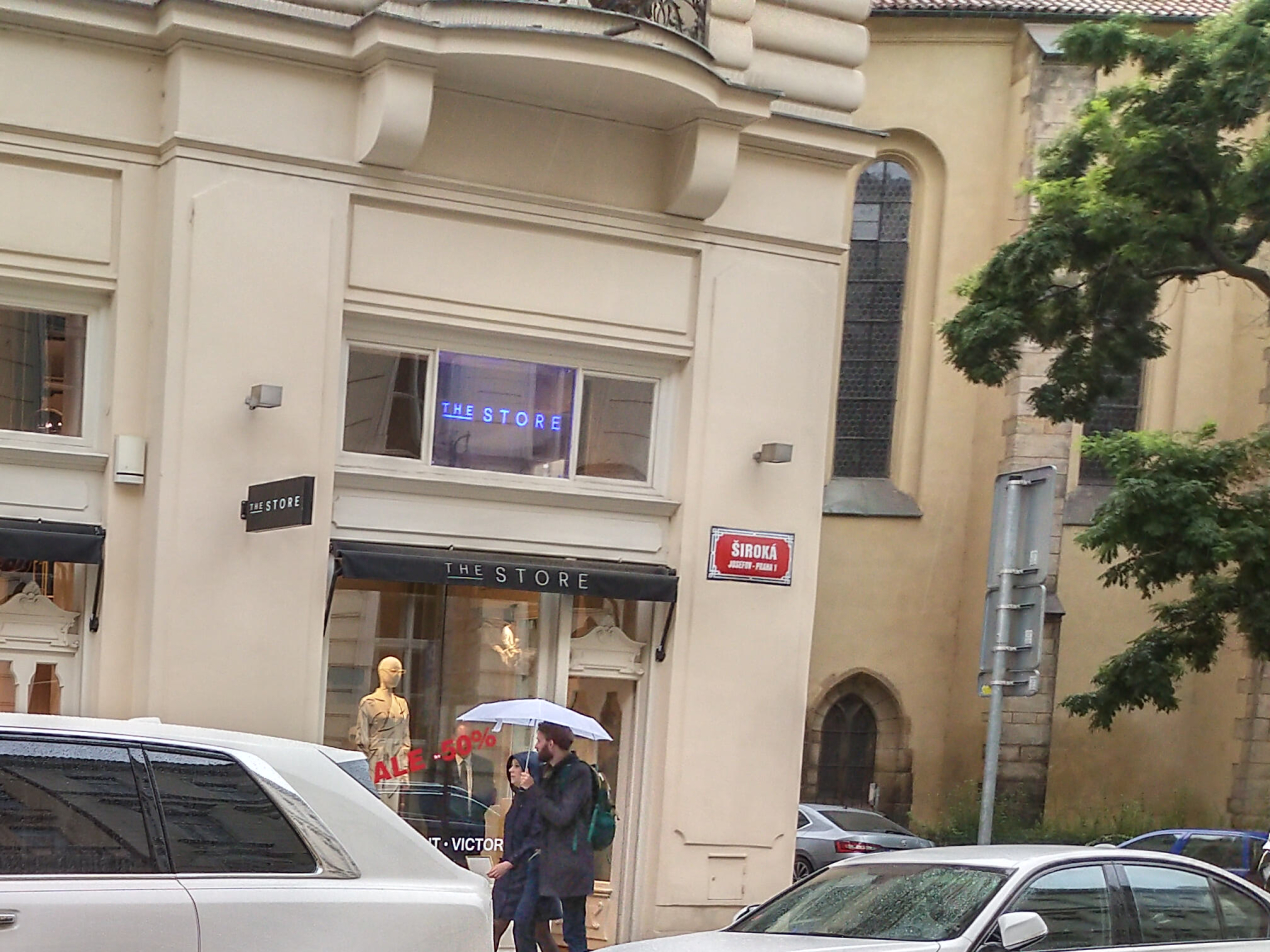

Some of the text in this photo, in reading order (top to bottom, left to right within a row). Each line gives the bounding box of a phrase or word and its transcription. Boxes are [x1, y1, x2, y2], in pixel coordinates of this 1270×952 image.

[441, 401, 562, 431] THE STORE
[249, 495, 300, 512] THE STORE
[731, 539, 778, 561] ŠIROKÁ
[444, 562, 589, 590] THE STORE
[374, 748, 427, 784] ALE
